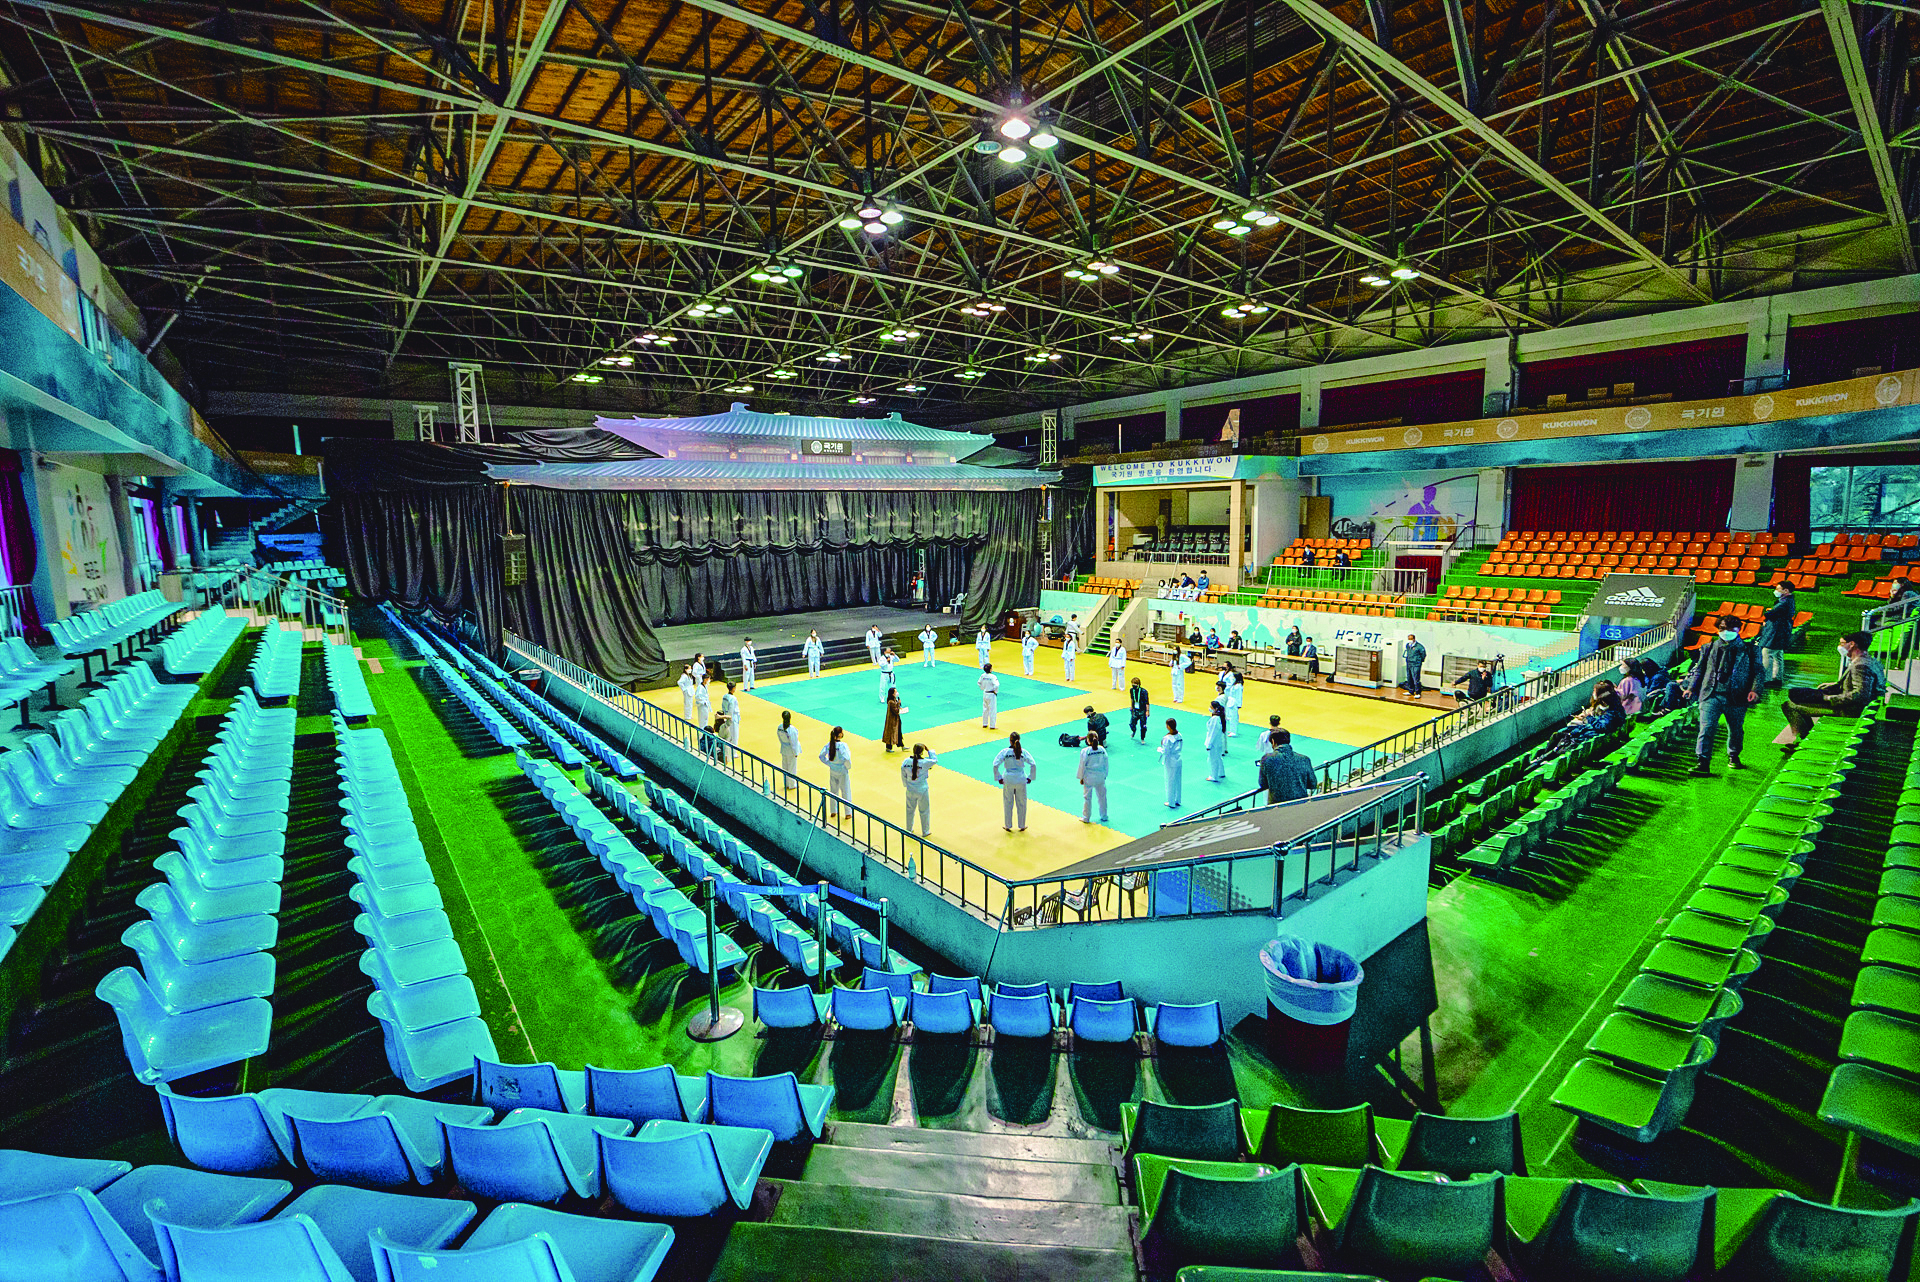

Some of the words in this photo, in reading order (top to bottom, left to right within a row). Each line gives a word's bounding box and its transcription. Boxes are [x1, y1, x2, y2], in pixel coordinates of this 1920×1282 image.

[1795, 392, 1849, 407] KUKKIWON
[1681, 407, 1725, 419] 국기원
[1542, 418, 1598, 430] KUKKIWON
[1443, 427, 1475, 438] 국기원
[823, 442, 844, 450] 국기원
[1345, 436, 1385, 445] KUKKIWON
[1100, 463, 1145, 472] WELCOME
[1170, 456, 1232, 467] KUKKIWON
[1111, 470, 1133, 478] 국기원
[1138, 468, 1162, 477] 방문을
[1604, 600, 1664, 608] taekwondo
[1606, 594, 1666, 604] adidas
[1604, 628, 1622, 639] G3
